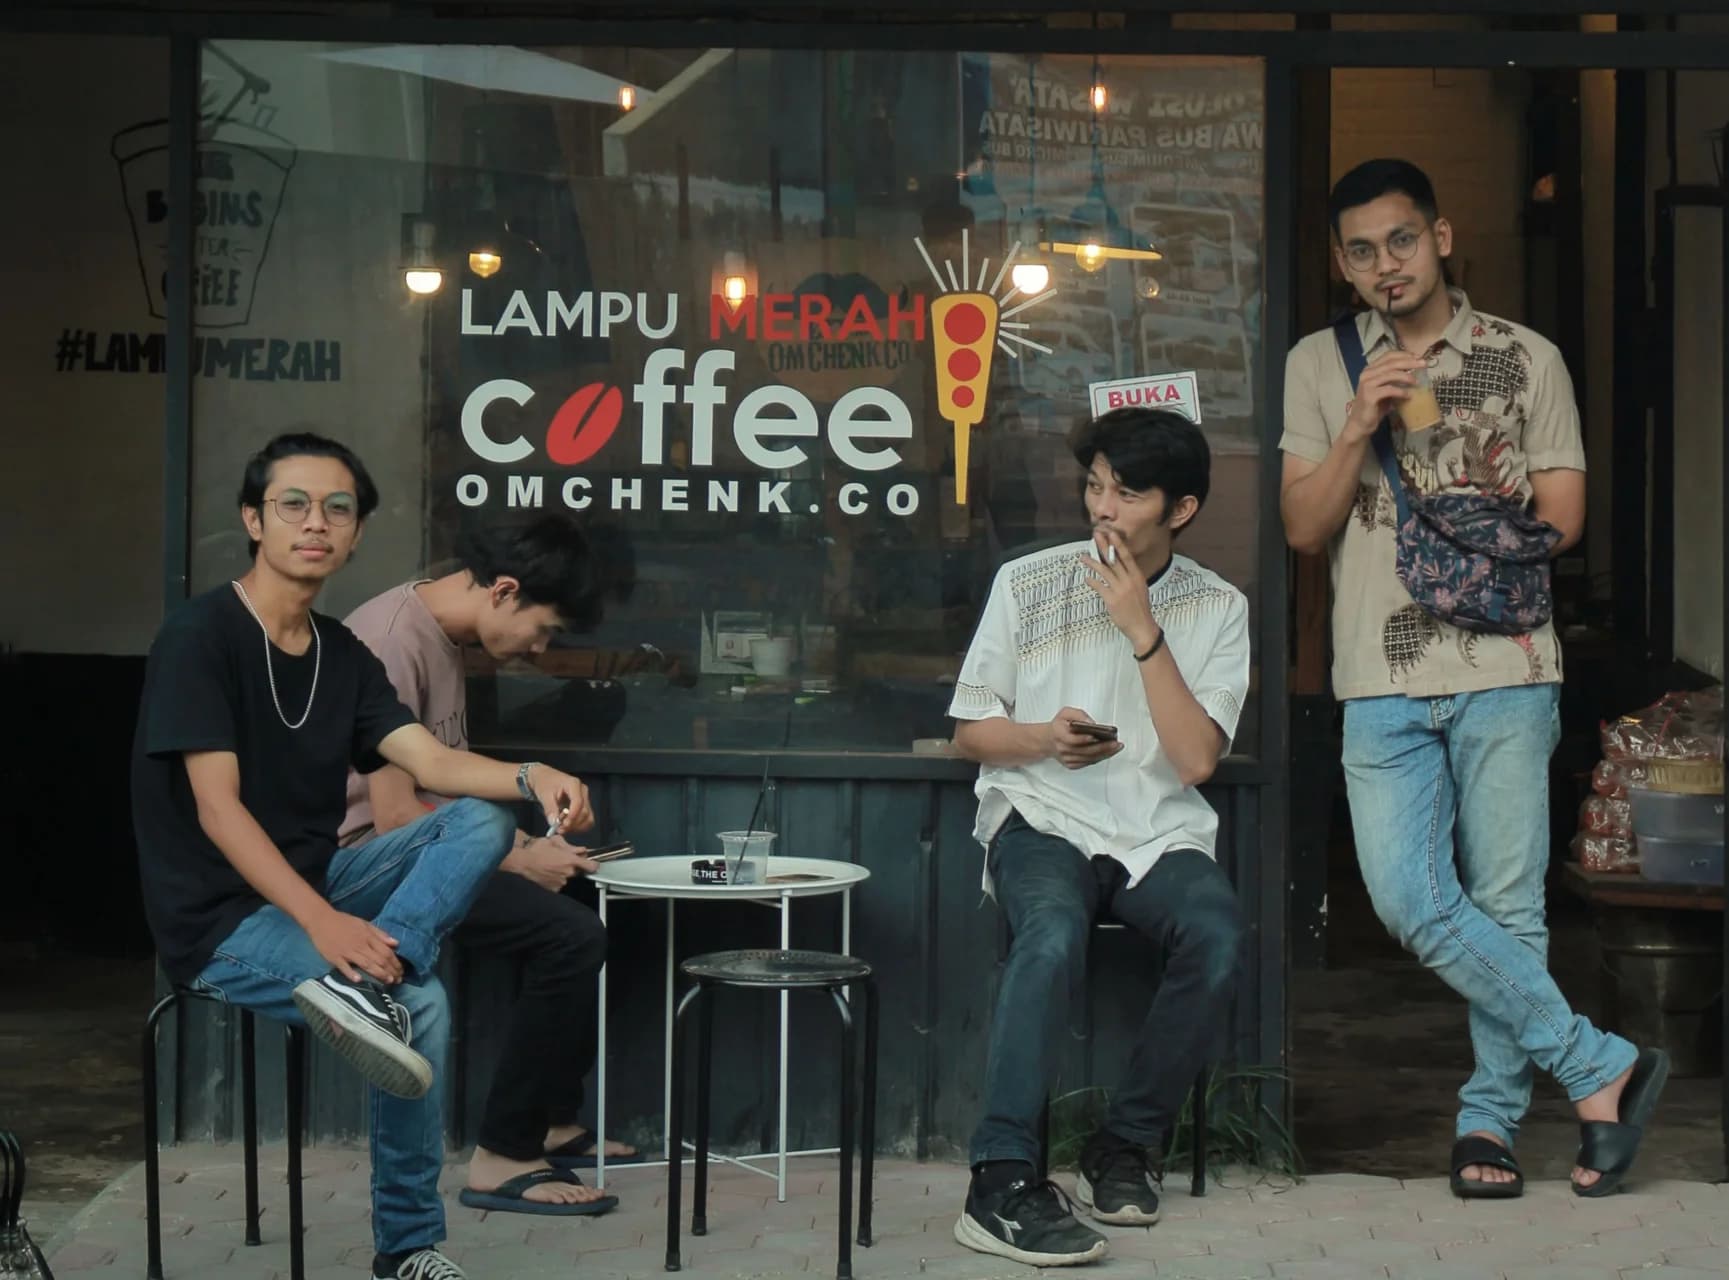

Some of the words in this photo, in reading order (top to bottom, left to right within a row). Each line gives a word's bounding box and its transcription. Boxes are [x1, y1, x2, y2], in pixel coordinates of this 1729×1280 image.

[461, 288, 678, 339] LAMPU
[709, 294, 925, 341] MERAH
[1108, 383, 1181, 409] BUKA
[455, 473, 920, 516] OMCHENK.CO
